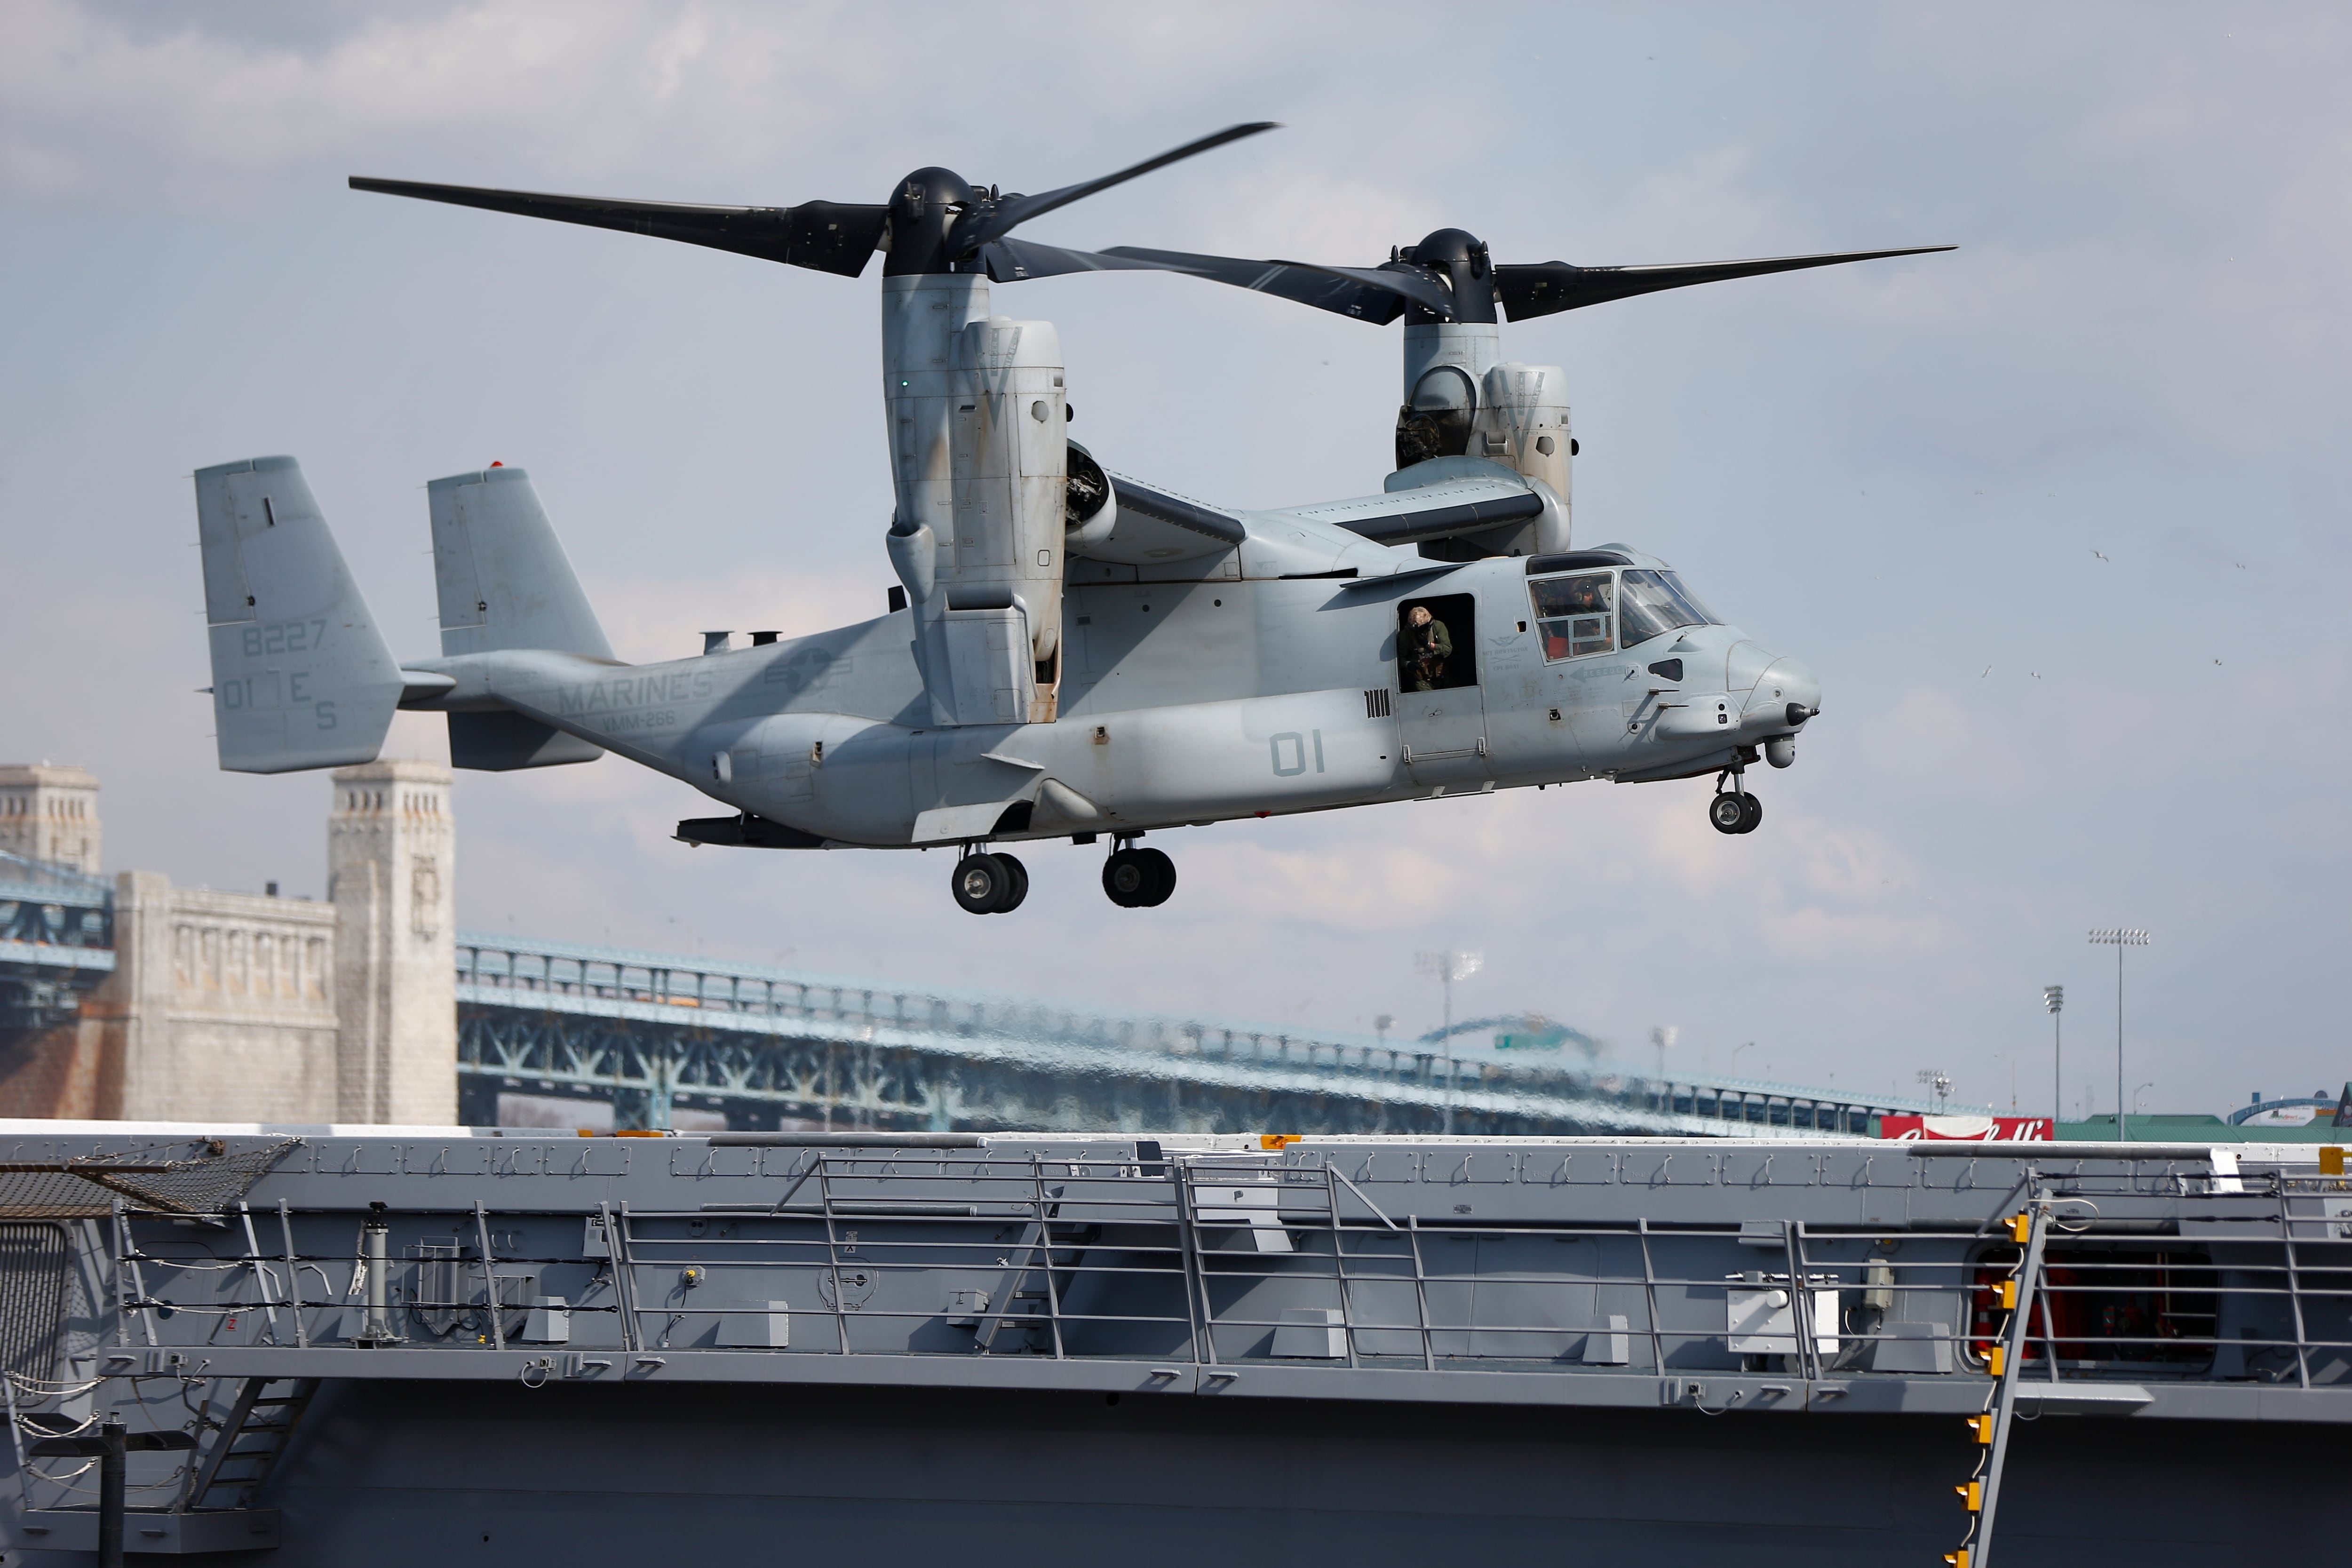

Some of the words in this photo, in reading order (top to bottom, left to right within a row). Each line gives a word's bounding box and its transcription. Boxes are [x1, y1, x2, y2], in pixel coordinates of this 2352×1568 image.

[243, 620, 327, 657] 8227
[291, 672, 311, 702] E
[1582, 667, 1622, 678] RESCUE
[224, 679, 253, 709] 01
[558, 671, 713, 713] MARINES
[316, 701, 337, 730] S
[602, 709, 675, 732] VMM-266
[1270, 729, 1325, 777] 01
[227, 1319, 237, 1329] Z
